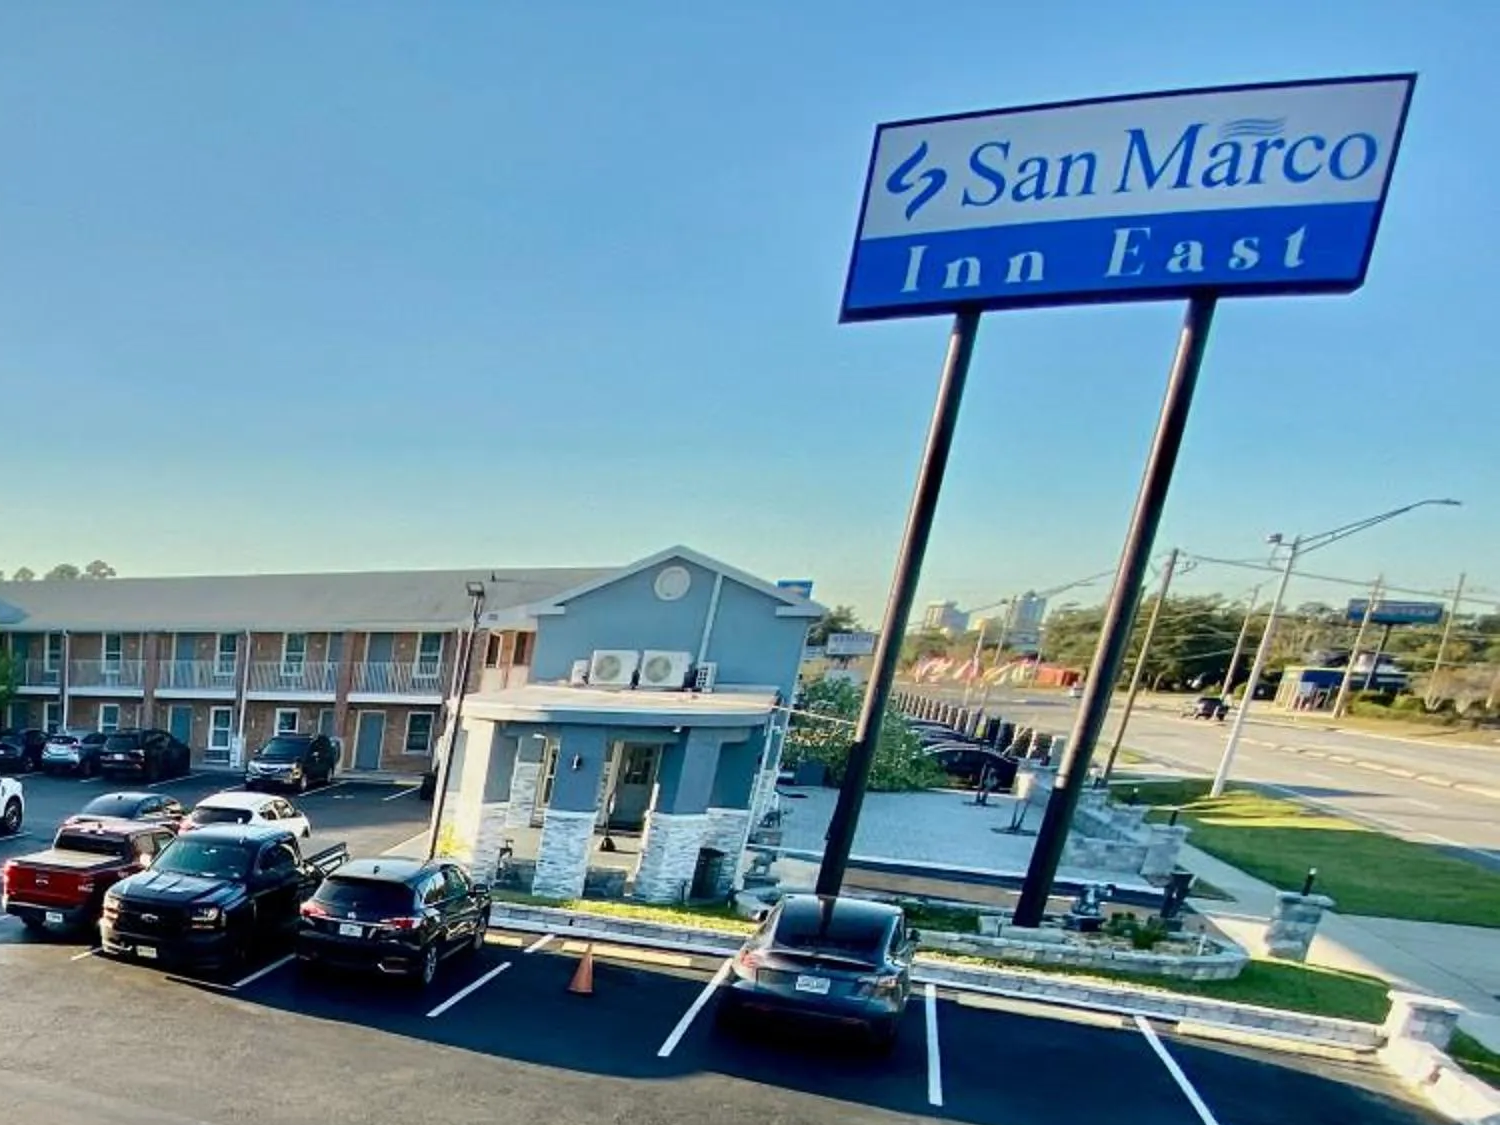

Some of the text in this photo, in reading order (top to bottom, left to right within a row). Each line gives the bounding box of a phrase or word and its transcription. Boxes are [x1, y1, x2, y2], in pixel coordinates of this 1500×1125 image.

[960, 122, 1379, 208] San Marco
[900, 222, 1308, 293] Inn East
